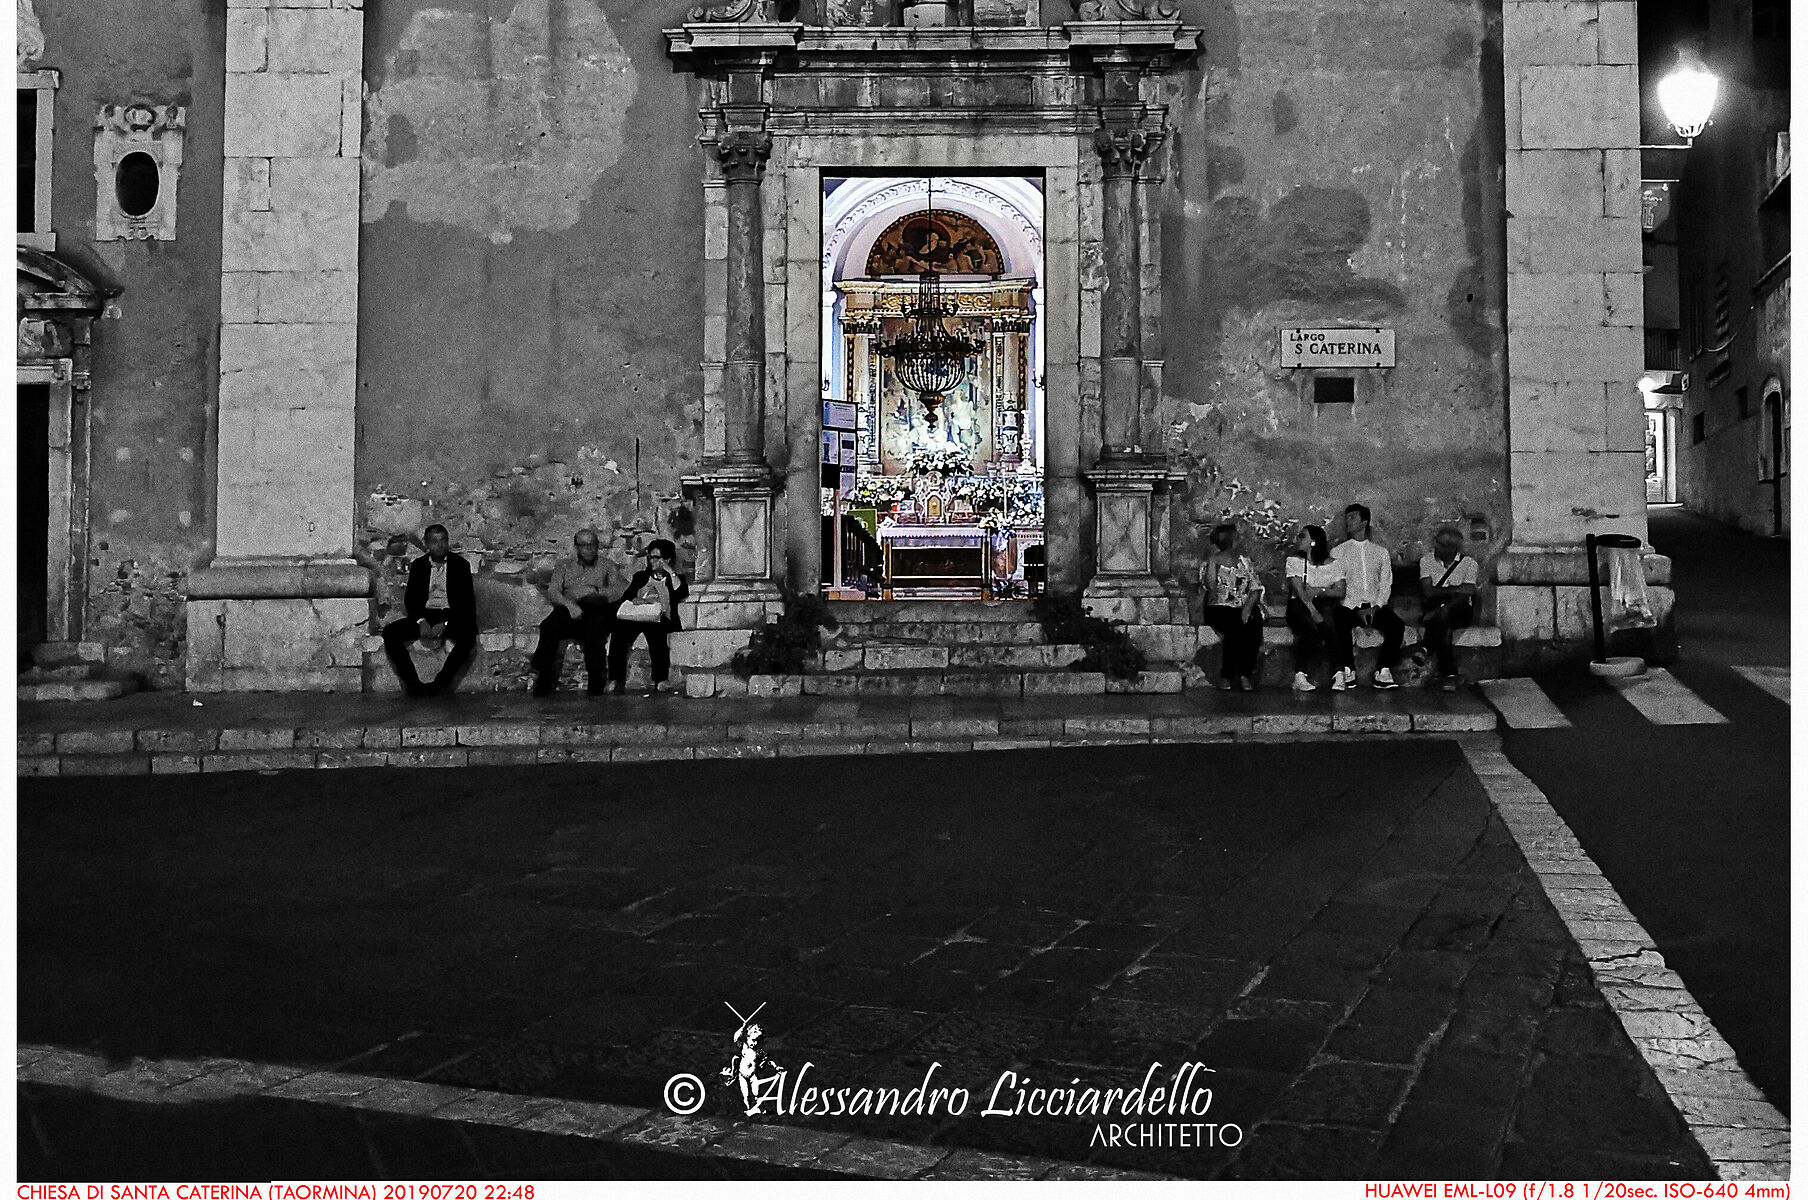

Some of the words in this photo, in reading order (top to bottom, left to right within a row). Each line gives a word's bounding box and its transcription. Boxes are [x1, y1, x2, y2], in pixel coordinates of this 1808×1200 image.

[1290, 333, 1326, 342] LARGO
[1295, 343, 1303, 355] S
[1309, 343, 1382, 355] CATERINA
